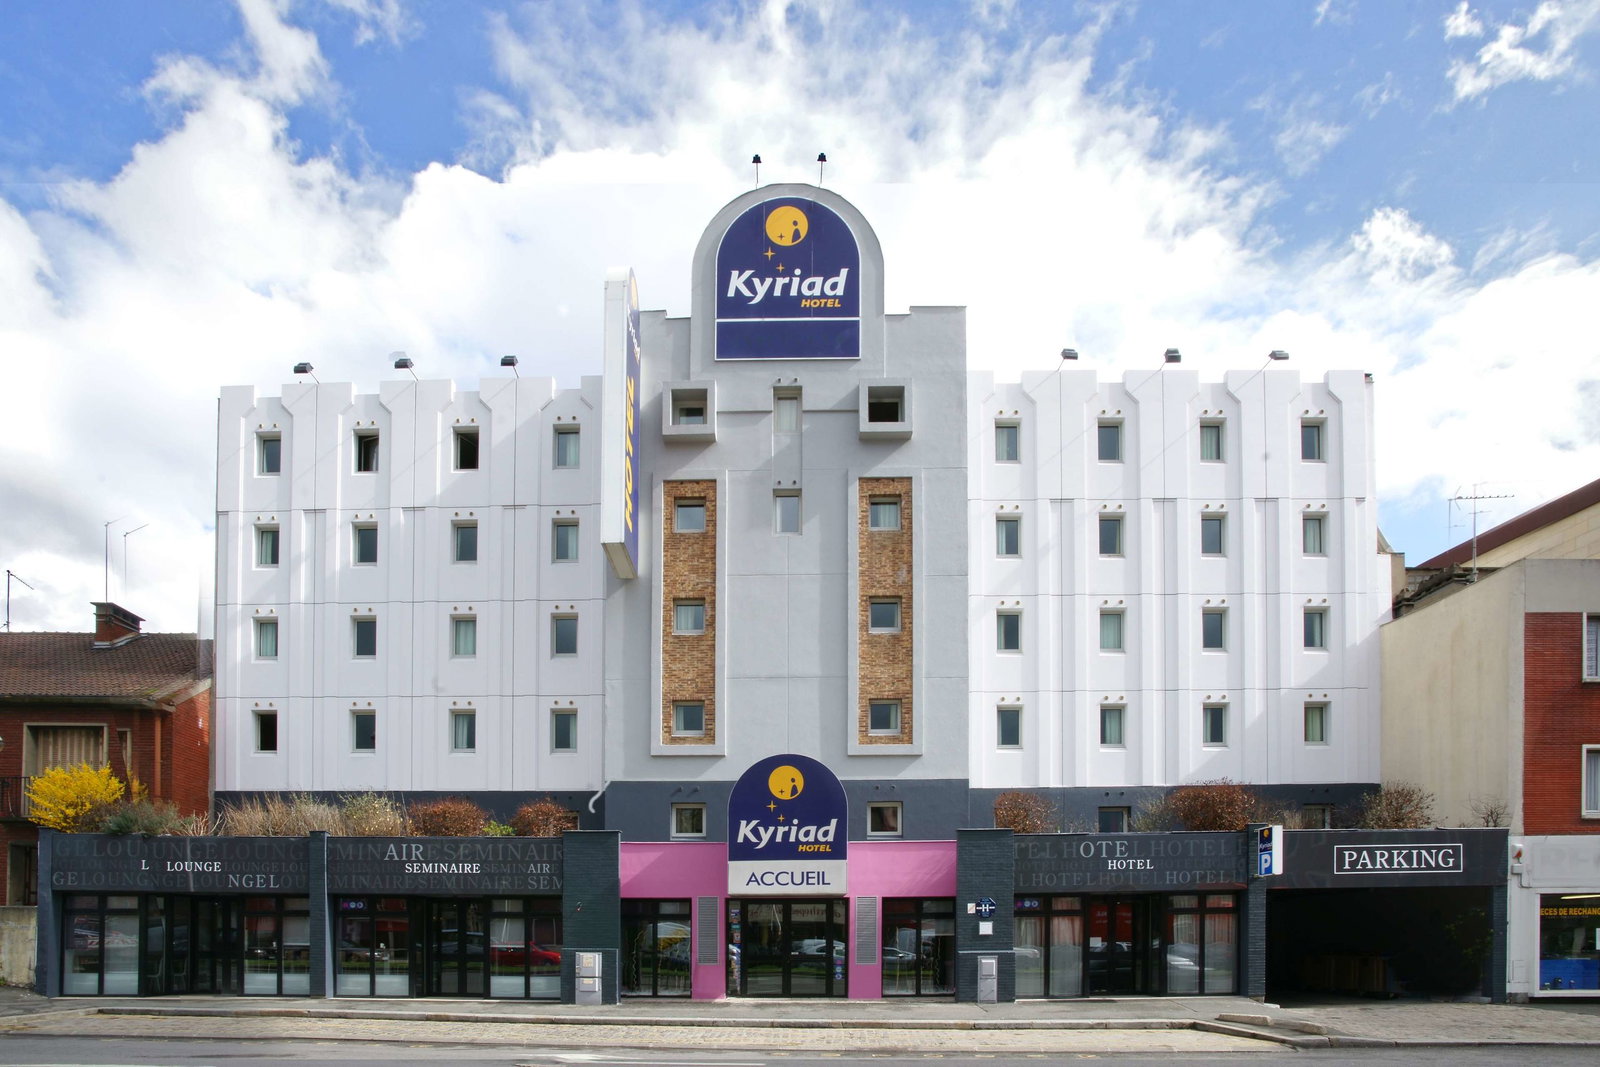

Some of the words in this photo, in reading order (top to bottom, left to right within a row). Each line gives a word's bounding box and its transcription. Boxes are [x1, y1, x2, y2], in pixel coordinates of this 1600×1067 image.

[727, 268, 849, 304] Kyriad
[801, 298, 841, 307] HOTEL
[626, 376, 634, 532] HOTEL
[737, 818, 838, 849] Kyriad
[798, 844, 832, 852] HOTEL
[1107, 859, 1154, 870] HOTEL
[1261, 854, 1271, 875] P
[1342, 848, 1455, 869] PARKING
[166, 861, 222, 872] LOUNGE
[404, 863, 481, 874] SEMINAIRE
[746, 871, 831, 886] ACCUEIL
[1559, 907, 1568, 916] DE
